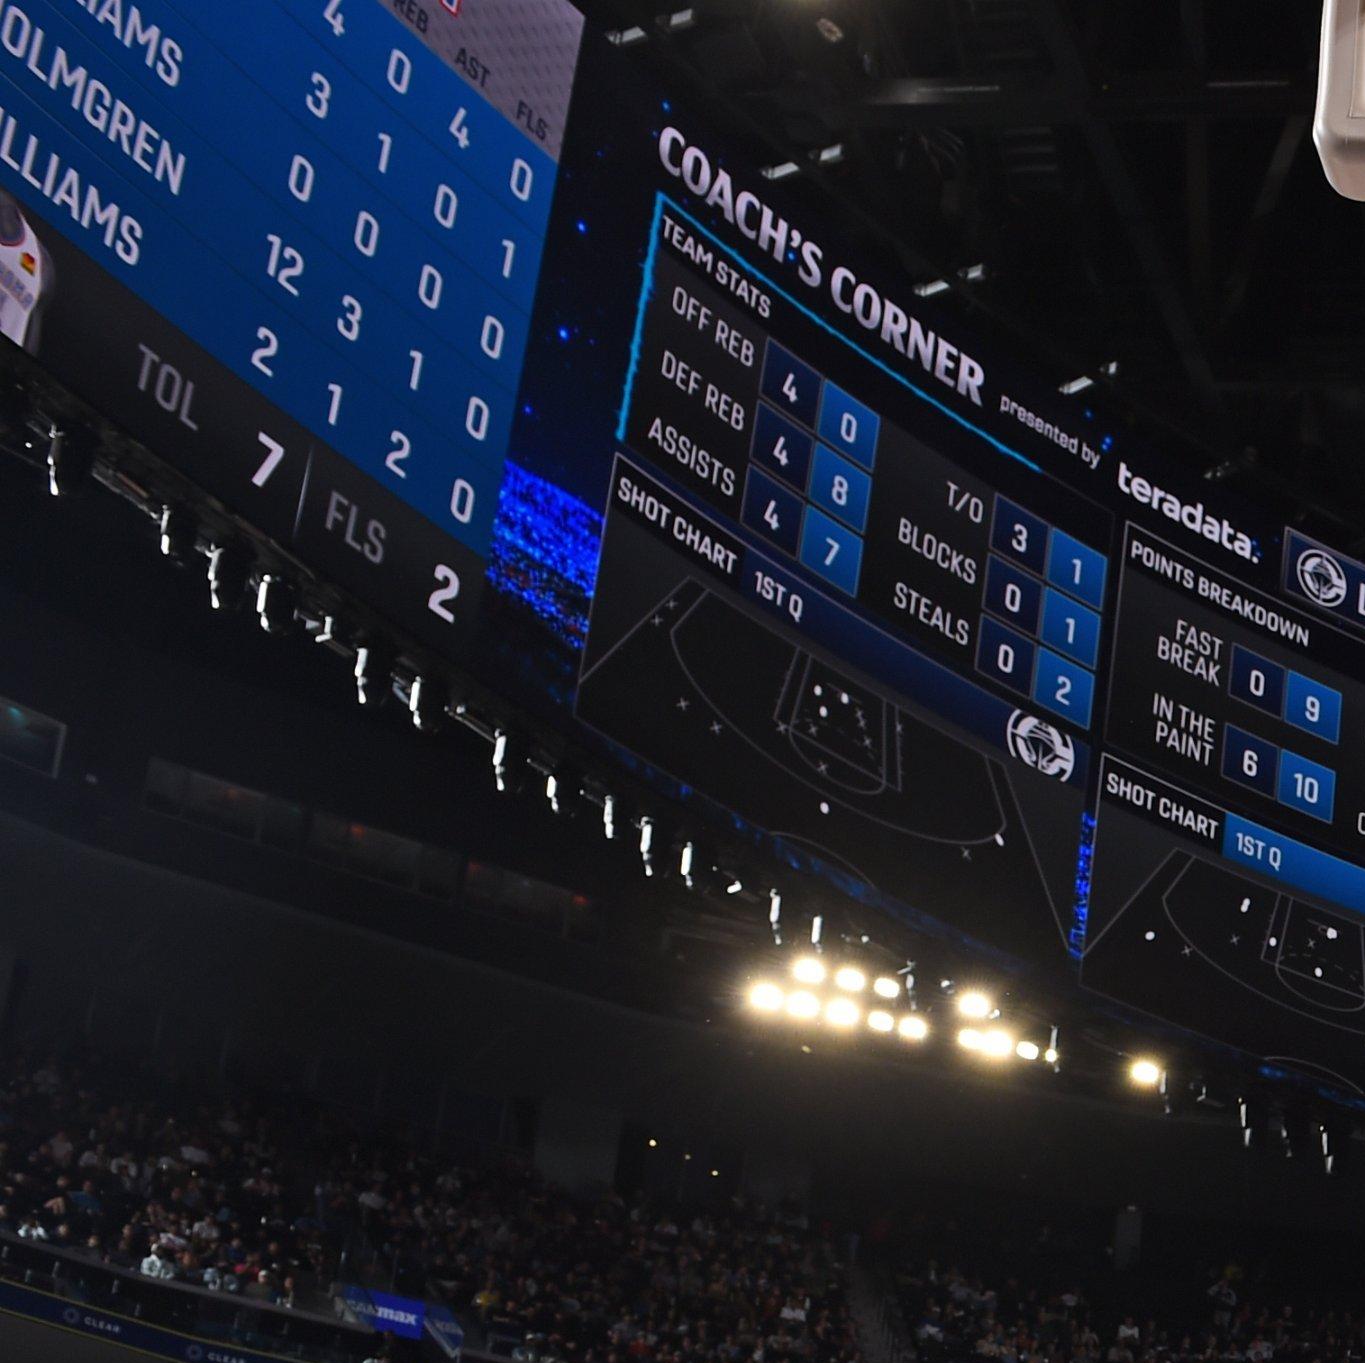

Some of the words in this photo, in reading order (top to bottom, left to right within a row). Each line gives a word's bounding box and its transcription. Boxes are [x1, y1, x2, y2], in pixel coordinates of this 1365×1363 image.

[454, 47, 491, 88] AST
[516, 100, 548, 141] FLS
[0, 107, 143, 266] LLIAMS
[658, 126, 823, 288] COACH'S
[830, 265, 986, 407] CORNER
[1000, 395, 1080, 455] presented
[1081, 440, 1101, 470] by
[660, 214, 714, 276] TEAM
[715, 257, 771, 319] STATS
[266, 233, 304, 296] 12
[337, 295, 362, 342] 3
[466, 396, 489, 441] 0
[673, 286, 711, 331] OFF
[715, 318, 755, 368] REB
[782, 372, 797, 403] 4
[841, 411, 857, 443] 0
[661, 349, 699, 397] DEF
[704, 384, 745, 432] REB
[773, 436, 788, 467] 4
[831, 475, 848, 506] 8
[138, 343, 199, 431] TOL
[251, 432, 284, 487] 7
[325, 489, 387, 564] FLS
[428, 565, 460, 624] 2
[648, 416, 735, 497] ASSISTS
[764, 500, 780, 531] 4
[824, 537, 840, 569] 7
[946, 480, 984, 525] T/O
[1011, 522, 1028, 553] 3
[617, 477, 672, 531] SHOT
[674, 513, 738, 575] CHART
[754, 571, 786, 609] 1ST
[788, 594, 803, 622] Q
[898, 518, 976, 585] BLOCKS
[1004, 582, 1021, 614] 0
[1131, 540, 1195, 590] POINTS
[1198, 569, 1309, 647] BREAKDOWN
[894, 582, 969, 645] STEALS
[997, 643, 1014, 674] 0
[1055, 675, 1072, 705] 2
[1157, 635, 1220, 687] BREAK
[1249, 667, 1265, 697] 0
[1305, 695, 1321, 723] 9
[1175, 619, 1222, 658] FAST
[1152, 693, 1172, 716] IN
[1179, 703, 1215, 743] THE
[1155, 721, 1214, 766] PAINT
[1242, 749, 1258, 776] 6
[1293, 771, 1318, 803] 10
[1106, 772, 1155, 811] SHOT
[1159, 796, 1219, 839] CHART
[1236, 831, 1266, 862] 1ST
[1267, 843, 1281, 870] Q
